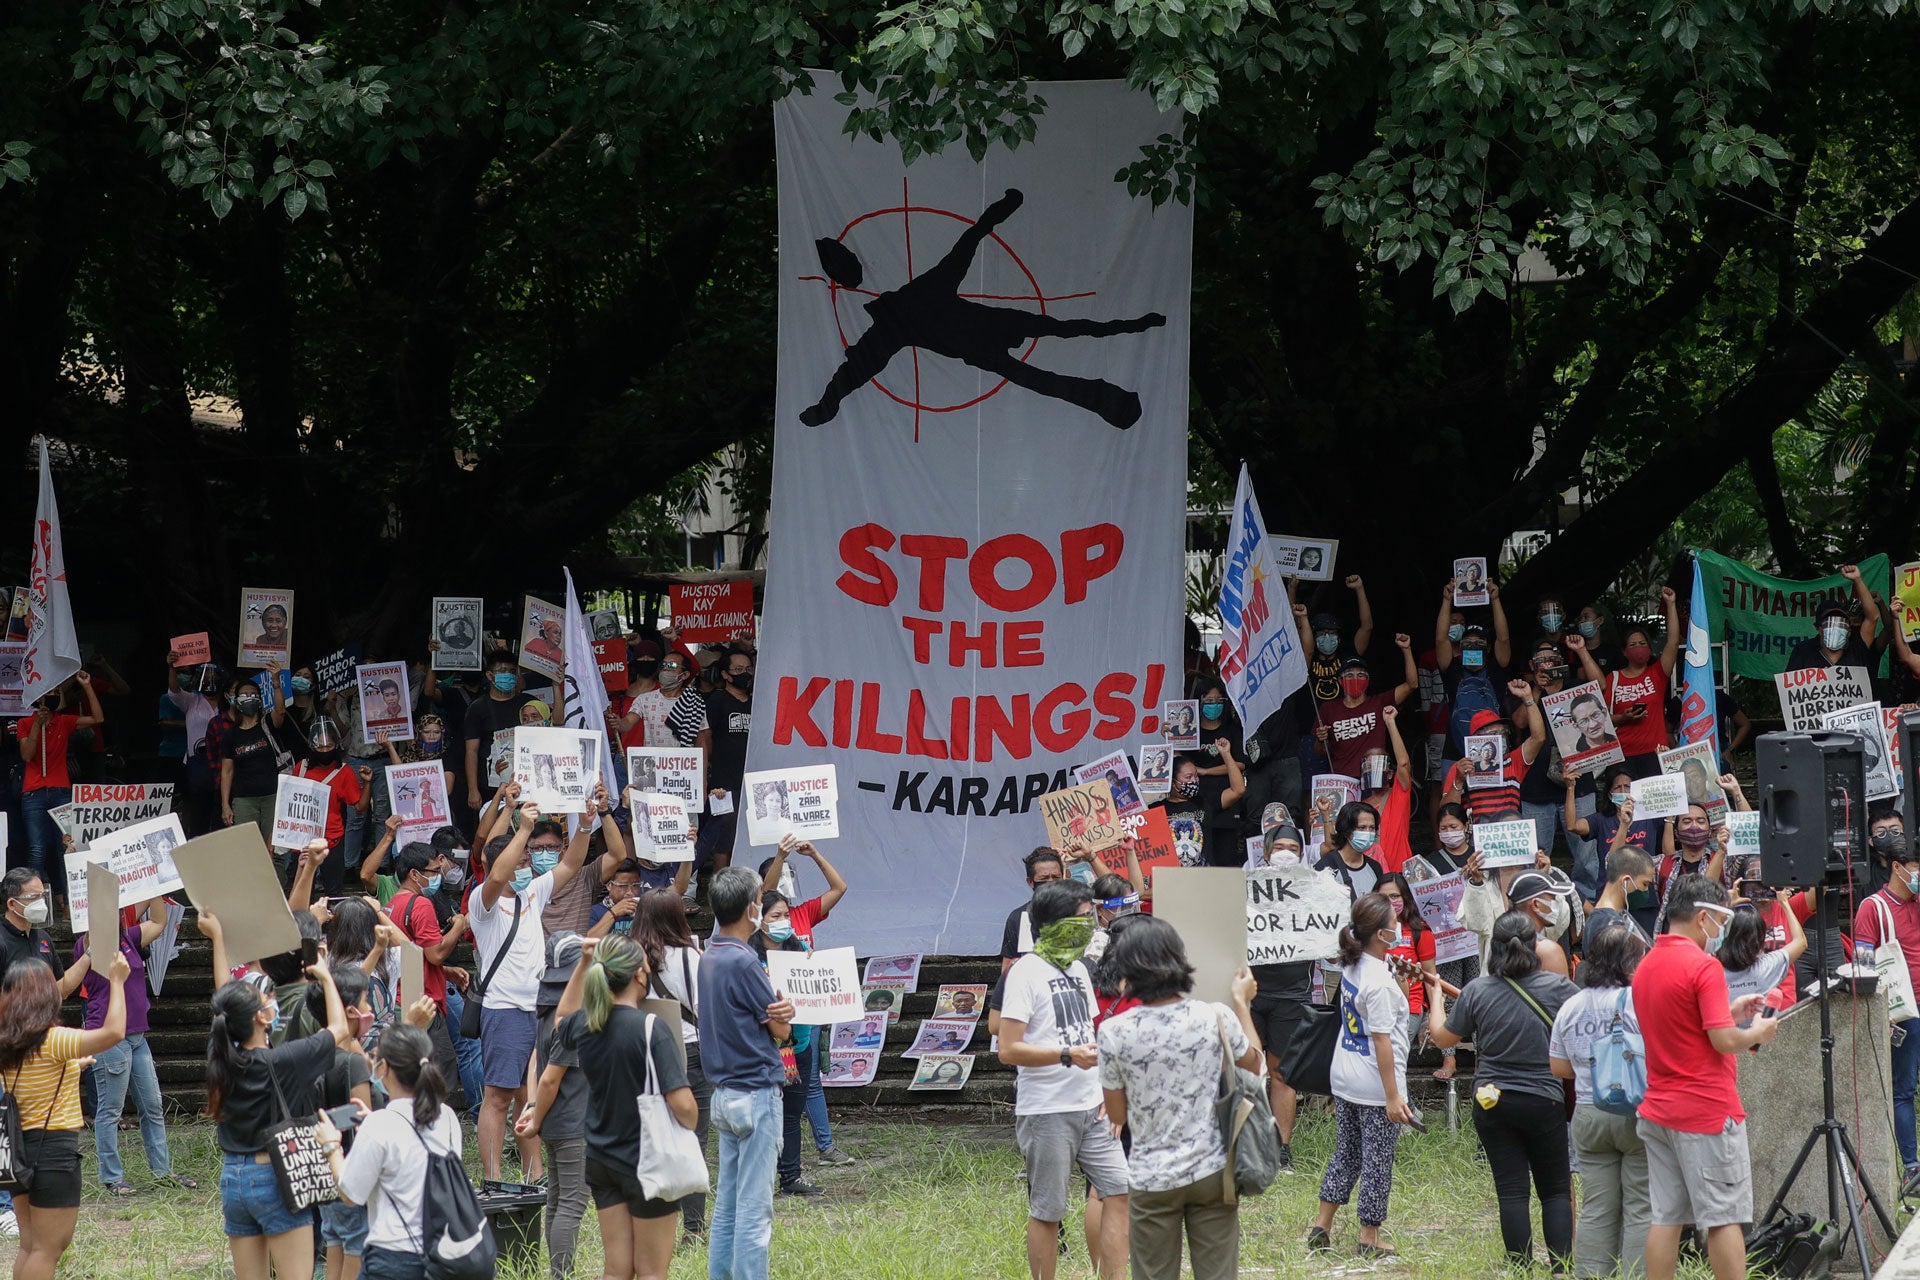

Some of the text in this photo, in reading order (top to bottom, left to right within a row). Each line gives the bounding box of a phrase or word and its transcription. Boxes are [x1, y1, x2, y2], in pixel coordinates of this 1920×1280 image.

[836, 522, 1124, 612] STOP
[247, 594, 288, 602] HUSTISYA!
[681, 584, 730, 598] HUSTISYA
[446, 603, 477, 611] JUSTICE!
[693, 598, 715, 611] KAY
[675, 614, 711, 629] RANDALL
[902, 616, 1044, 668] THE
[316, 656, 356, 682] TERROR
[360, 666, 402, 678] HUSTISYA!
[1784, 667, 1853, 688] LUPA SA
[1544, 683, 1598, 707] HUSTISYA!
[773, 664, 1166, 762] KILLINGS!
[1835, 712, 1874, 727] JUSTICE!
[1333, 712, 1376, 732] SERVE
[554, 756, 579, 767] JUSTICE
[1663, 745, 1708, 764] HUSTISYA!
[655, 757, 698, 771] JUSTICE
[1081, 756, 1122, 779] HUSTISYA!
[392, 766, 438, 779] HUSTISYA!
[562, 772, 577, 780] ZARA
[560, 785, 583, 794] ALVAREZ
[662, 777, 691, 793] Randy
[788, 778, 829, 793] JUSTICE
[858, 755, 1082, 816] -KARAPA
[74, 785, 173, 803] IBASURA ANG
[293, 792, 312, 803] STOP
[798, 796, 821, 806] ZARA
[72, 807, 130, 824] TERROR
[134, 802, 163, 819] LAW
[1046, 786, 1106, 826] HANDS
[792, 810, 830, 822] ALVAREZ
[277, 819, 289, 830] END
[657, 821, 678, 830] ZARA
[1478, 823, 1530, 833] HUSTISYA
[653, 834, 687, 844] ALVAREZ
[1479, 833, 1507, 842] PARA
[1483, 840, 1529, 850] CARLITO
[123, 840, 147, 855] Zara's
[1416, 876, 1462, 895] HUSTISYA!
[1423, 908, 1441, 916] STOP
[1292, 913, 1340, 932] LAW
[791, 968, 834, 977] STOP the
[787, 978, 842, 994] KILLINGS!
[795, 998, 827, 1008] IMPUNITY
[830, 993, 856, 1006] NOW!
[924, 1023, 969, 1031] HUSTISYA!
[275, 1127, 296, 1143] THE
[283, 1149, 326, 1171] UNIVE
[287, 1166, 309, 1182] THE
[290, 1174, 335, 1195] POLYTE
